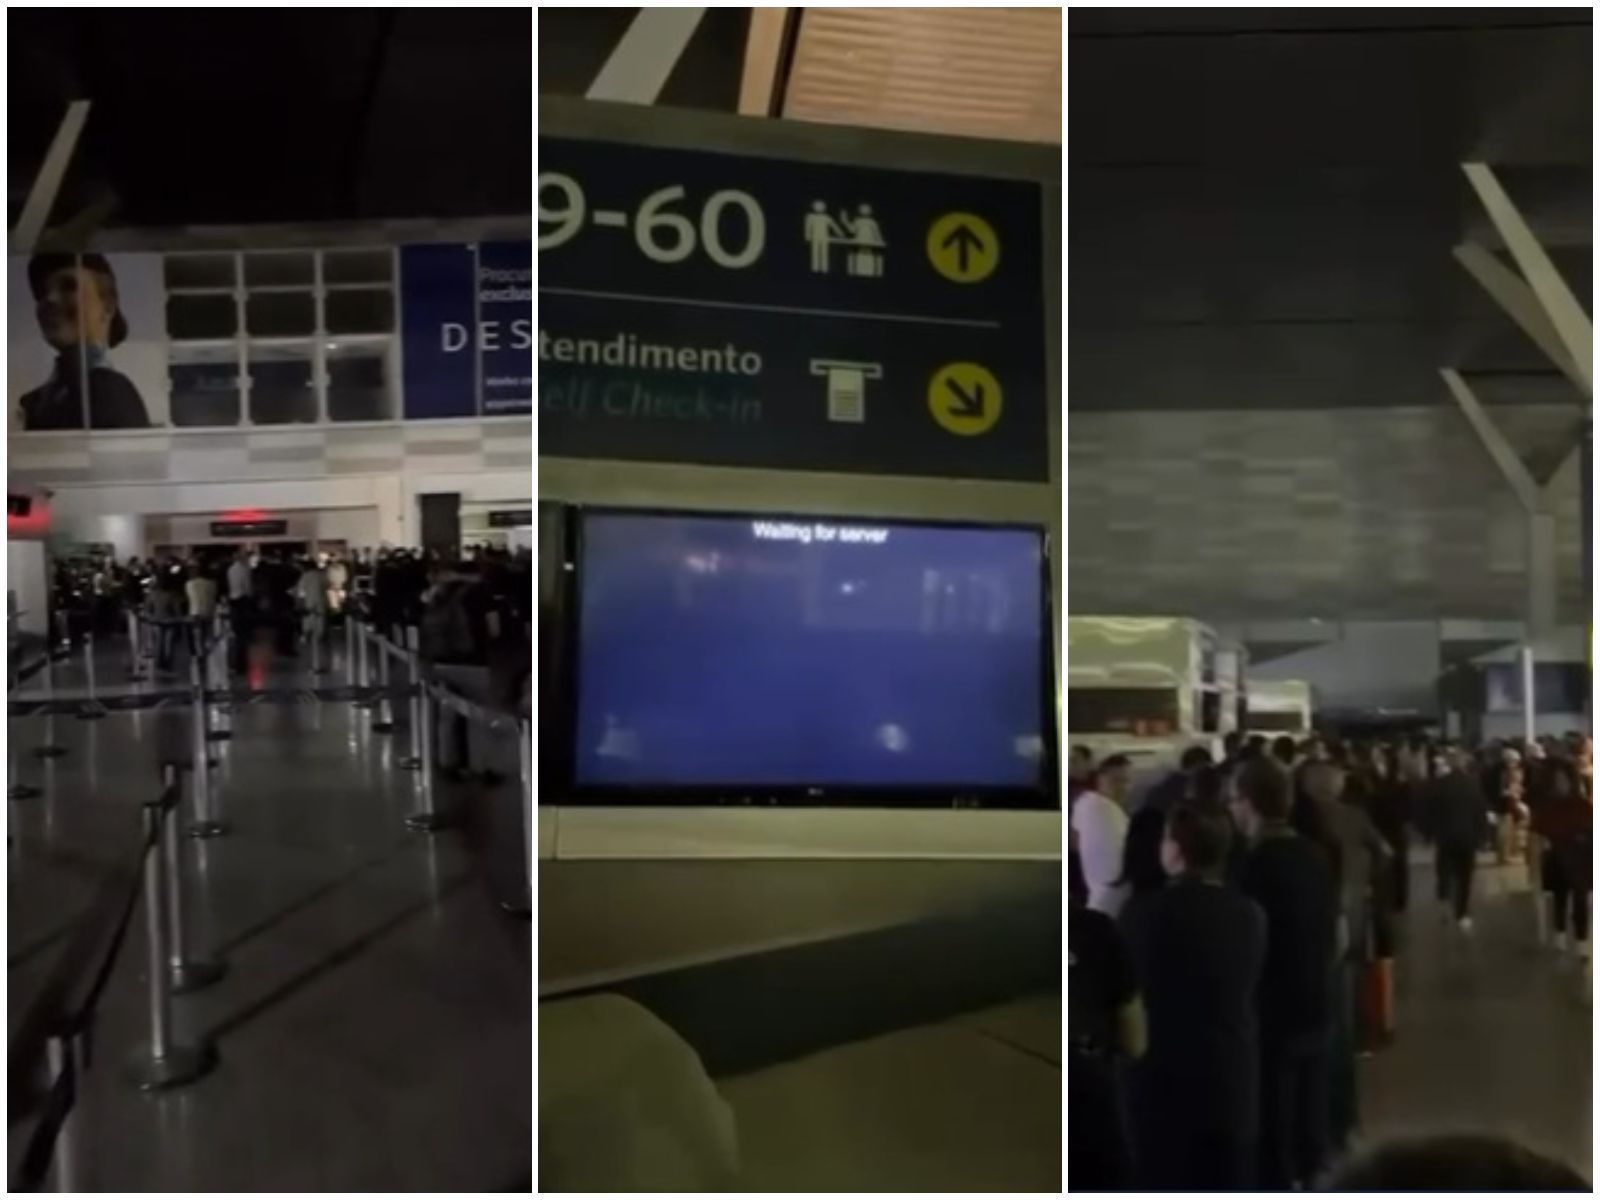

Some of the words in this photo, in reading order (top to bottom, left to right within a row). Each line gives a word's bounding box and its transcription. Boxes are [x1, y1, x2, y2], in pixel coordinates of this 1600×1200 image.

[752, 520, 812, 544] Waiting
[814, 522, 836, 541] for
[838, 527, 889, 543] server
